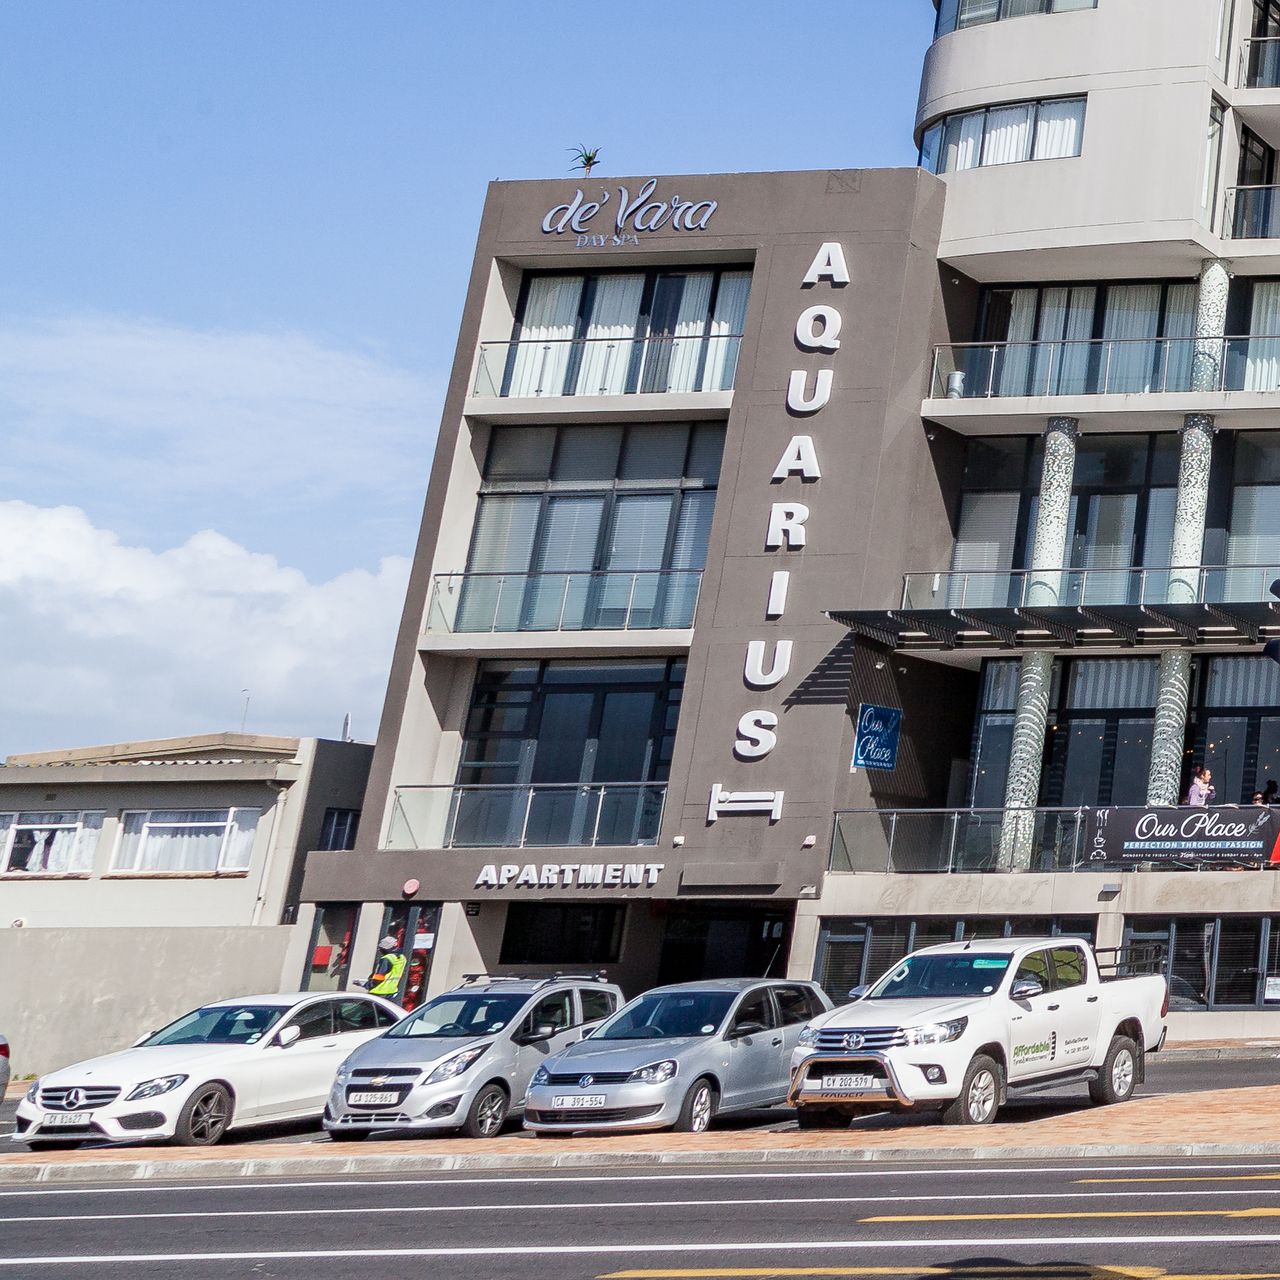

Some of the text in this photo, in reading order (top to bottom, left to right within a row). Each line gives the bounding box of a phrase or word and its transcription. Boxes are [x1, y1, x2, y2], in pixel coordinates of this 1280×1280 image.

[615, 178, 718, 234] Vara
[576, 233, 640, 247] DAY SPA
[733, 241, 851, 757] AQUARIUS
[862, 707, 884, 733] Our
[857, 735, 891, 761] Place
[1135, 812, 1247, 839] Our Place
[1123, 841, 1177, 849] PERFECTION
[475, 864, 665, 885] APARTMENT
[1013, 1040, 1050, 1058] Affordable
[826, 1078, 836, 1087] CY
[556, 1098, 564, 1106] CA
